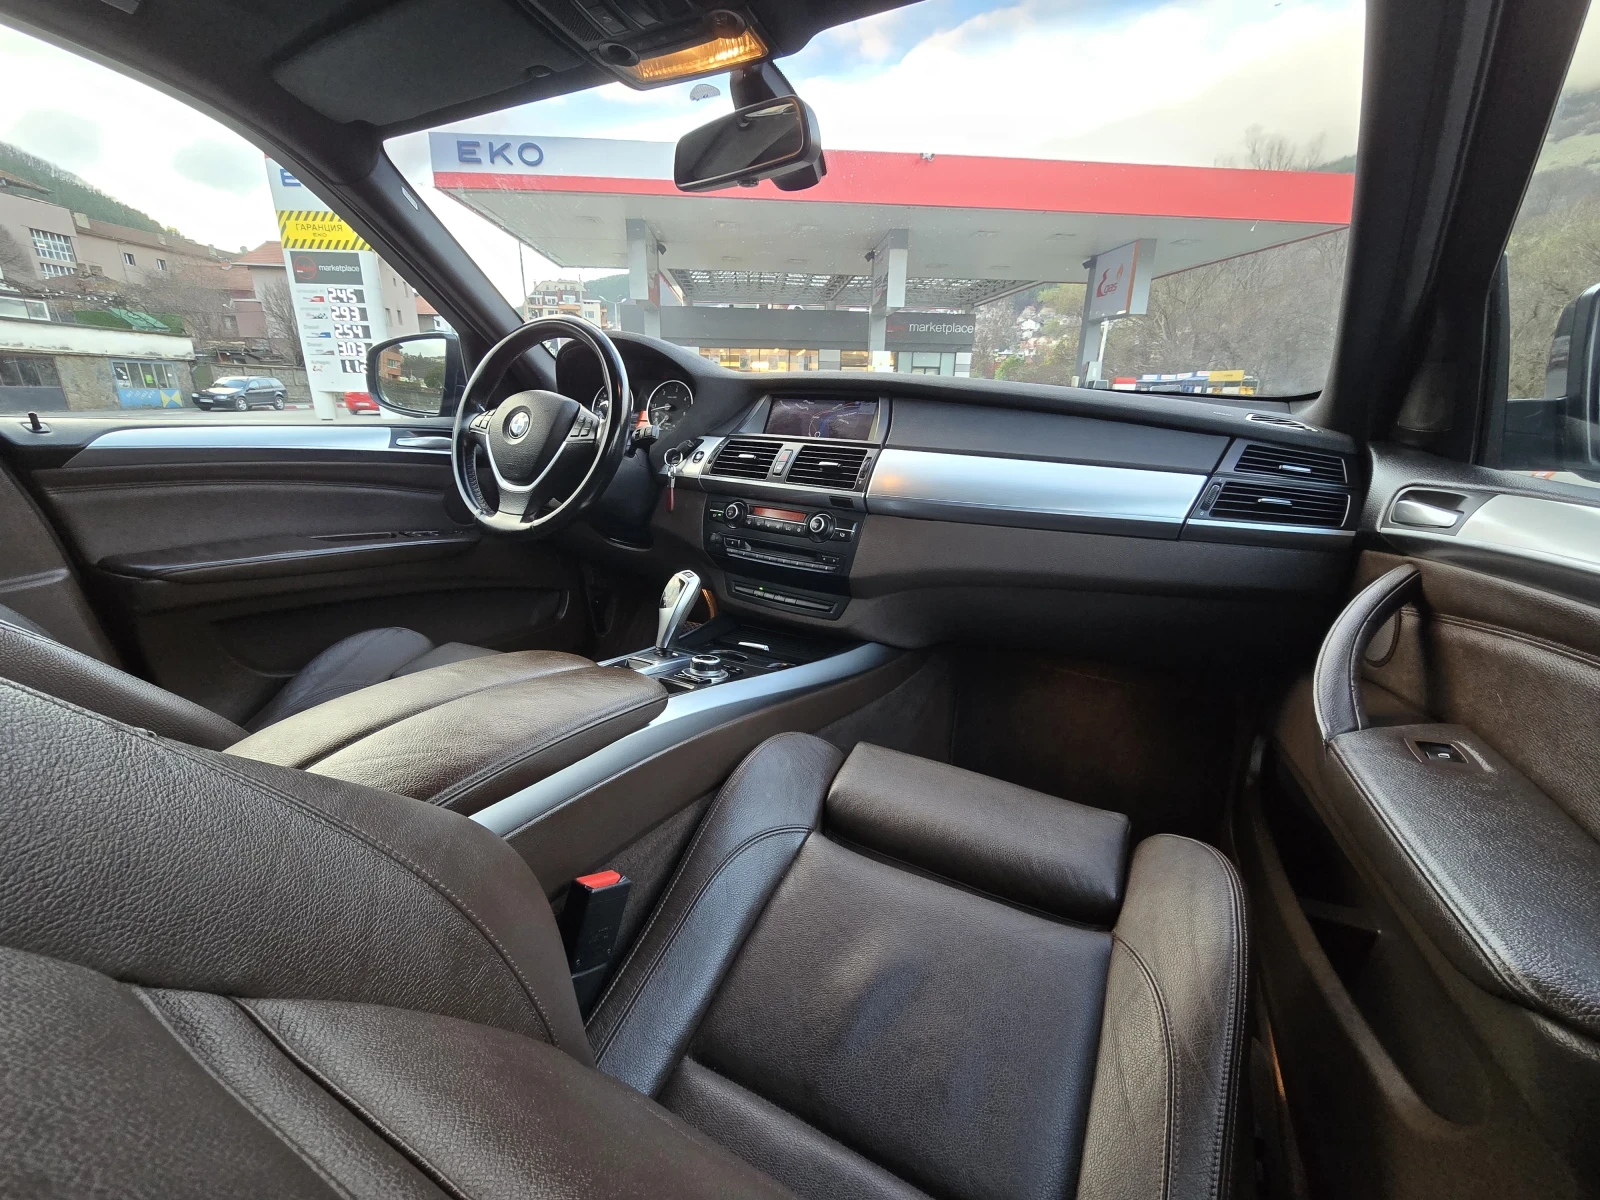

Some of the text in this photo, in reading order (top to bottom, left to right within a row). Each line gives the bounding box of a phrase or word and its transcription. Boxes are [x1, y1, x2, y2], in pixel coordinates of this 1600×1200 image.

[456, 140, 544, 167] EKO
[295, 223, 343, 232] ГАРАНЦИЯ
[318, 264, 360, 273] marketplace
[908, 322, 974, 335] marketplace
